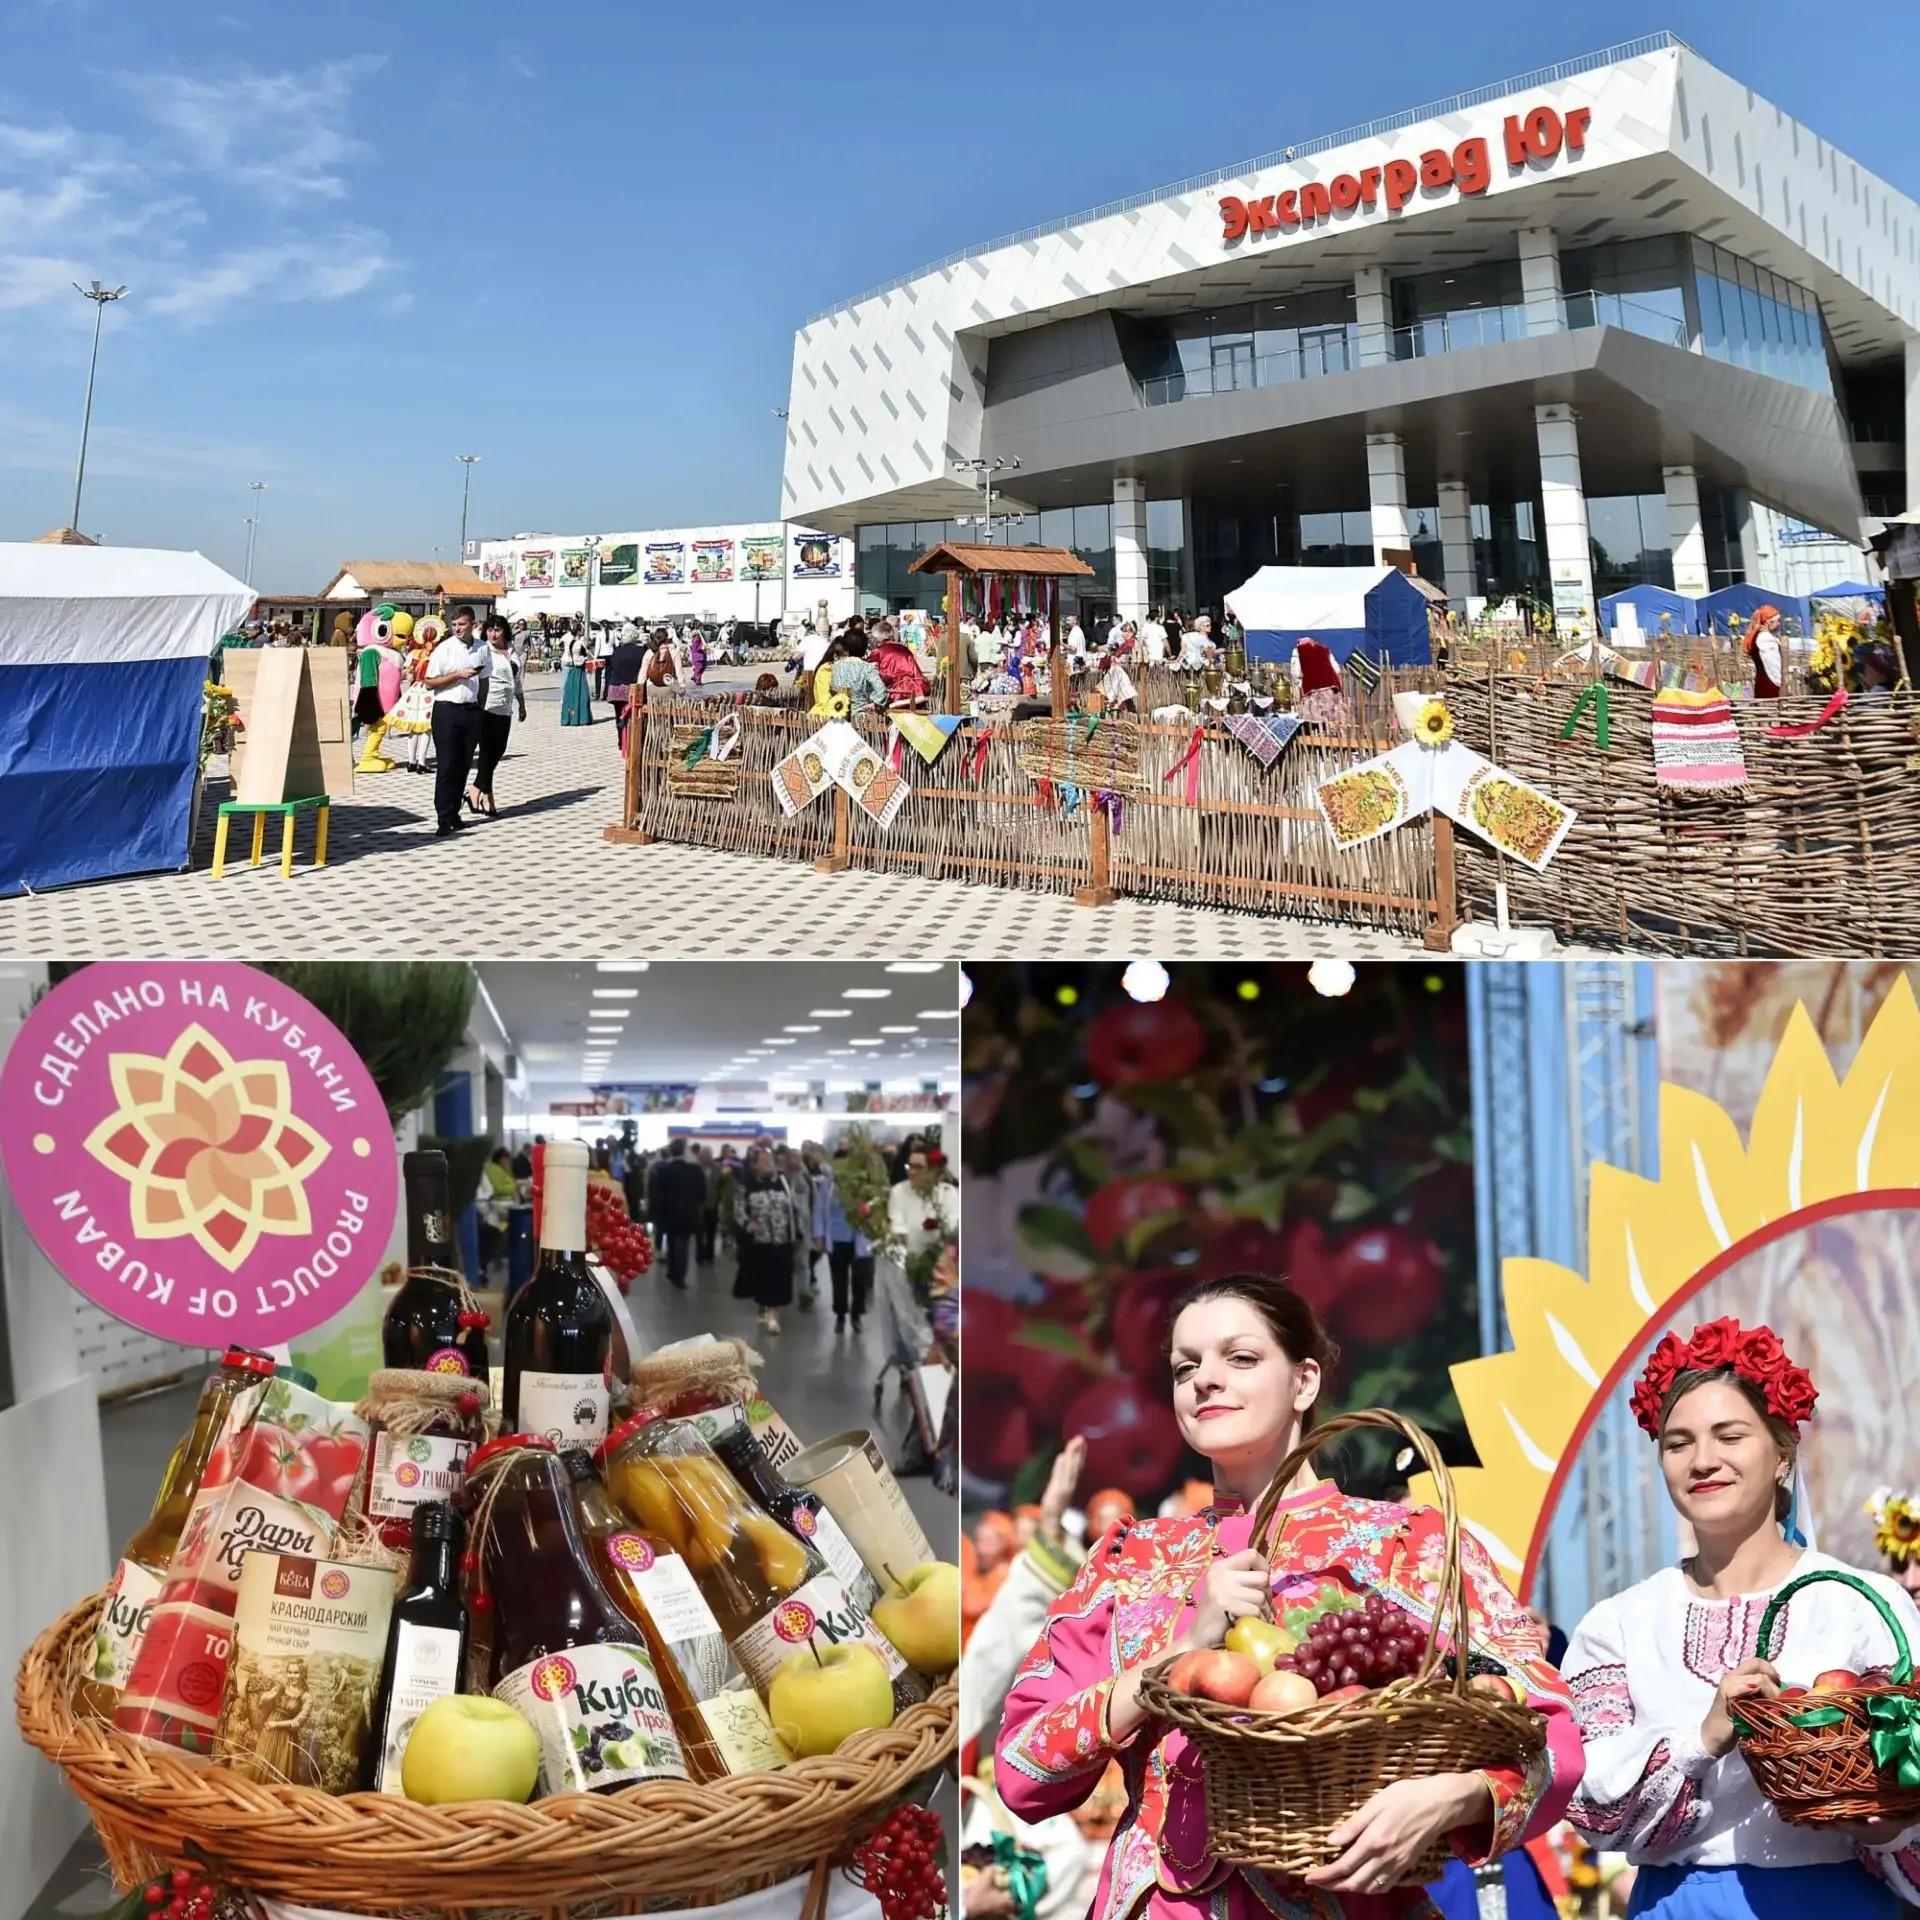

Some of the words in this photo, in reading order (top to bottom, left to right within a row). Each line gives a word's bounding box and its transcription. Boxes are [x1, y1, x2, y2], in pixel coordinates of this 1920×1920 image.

[1218, 136, 1491, 240] Экспоград
[1503, 105, 1590, 164] Юг
[34, 979, 166, 1106] СДЕЛАНО
[180, 979, 230, 1012] НА
[243, 996, 357, 1112] КУБАНИ
[53, 1189, 175, 1305] KUBAN
[255, 1189, 369, 1315] PRODUCT
[188, 1288, 237, 1318] OF
[233, 1506, 315, 1553] Дары
[204, 1633, 230, 1659] ТО
[270, 1601, 368, 1628] КРАСНОДАРСКИЙ
